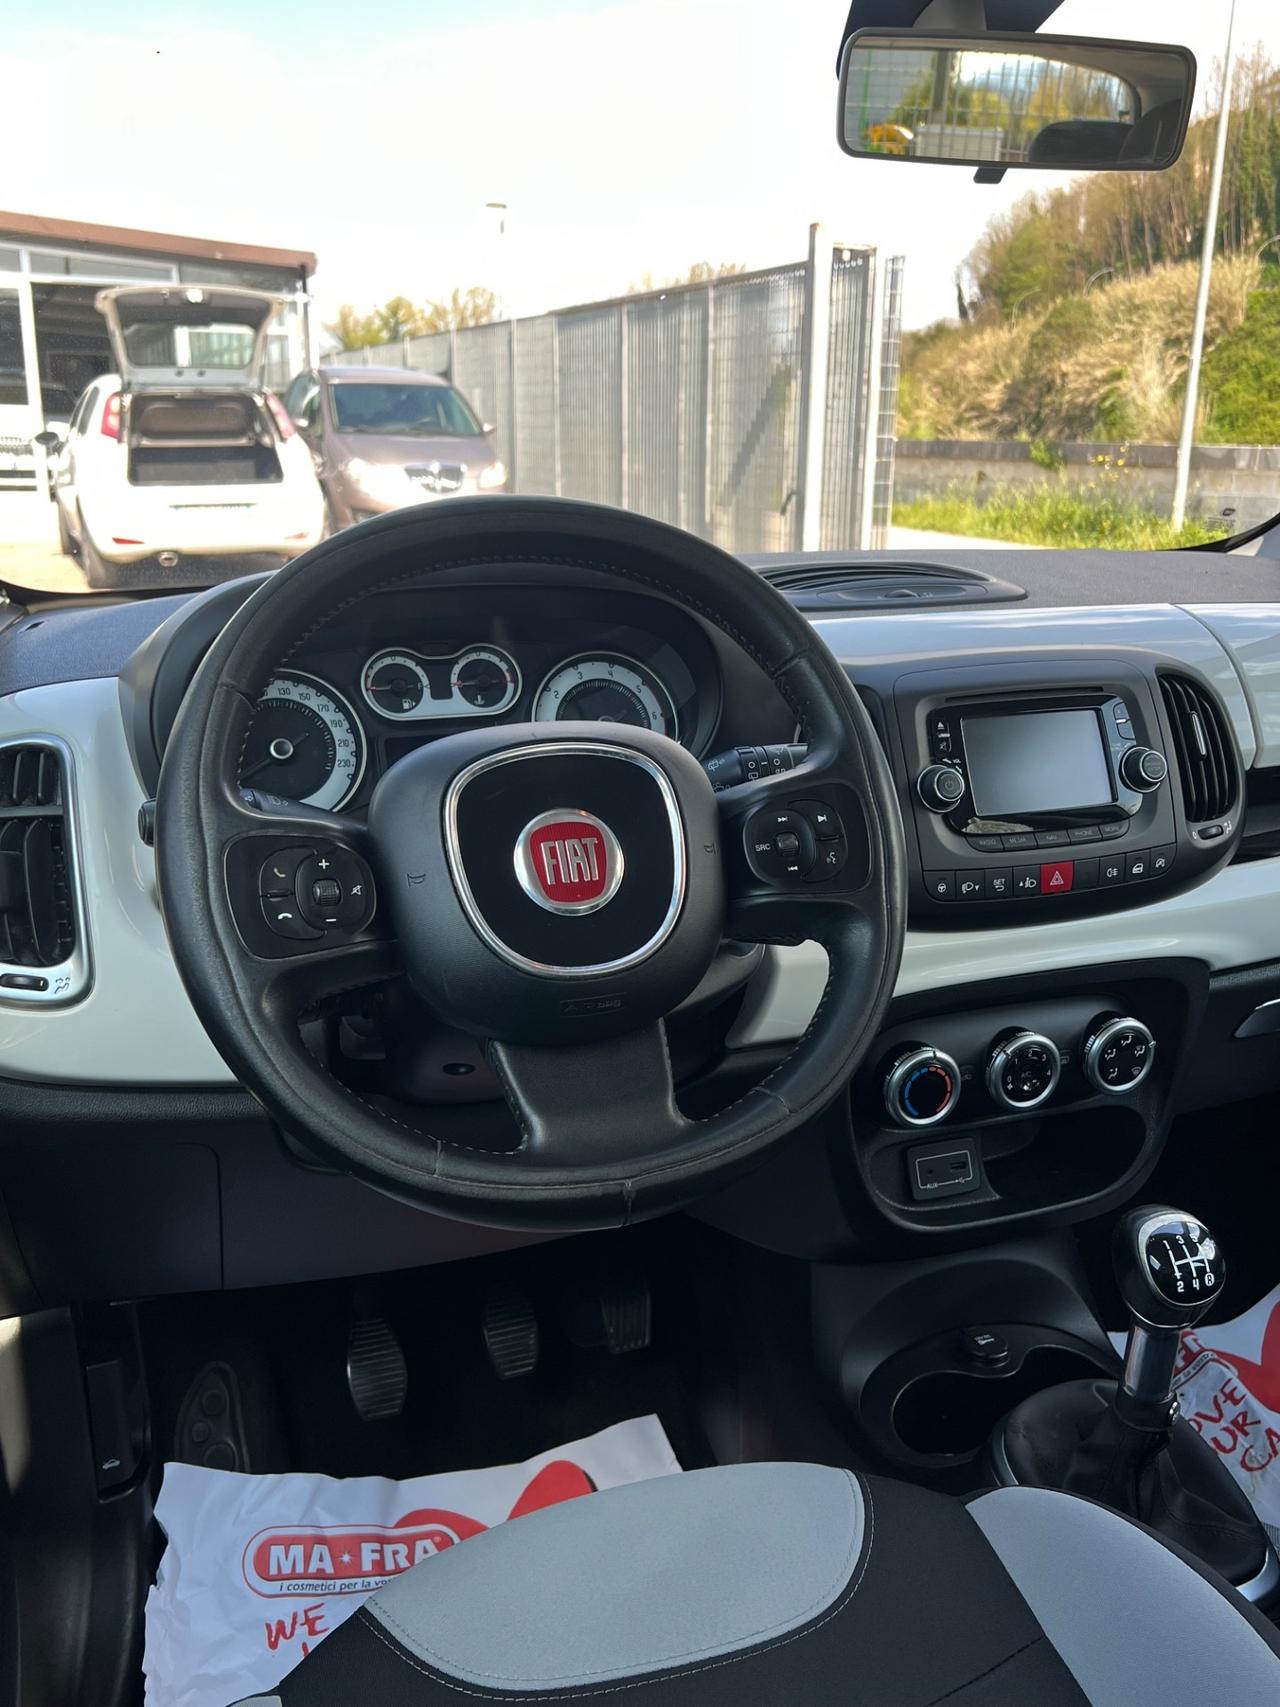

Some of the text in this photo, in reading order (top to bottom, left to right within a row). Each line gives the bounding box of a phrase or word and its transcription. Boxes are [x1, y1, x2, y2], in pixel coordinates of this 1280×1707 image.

[577, 671, 583, 680] 3
[607, 669, 614, 678] 4
[277, 687, 291, 696] 130
[636, 685, 642, 694] 5
[298, 692, 311, 701] 150
[553, 690, 560, 699] 2
[316, 703, 330, 713] 170
[651, 711, 658, 720] 6
[330, 719, 343, 728] 190
[337, 738, 350, 747] 210
[337, 759, 350, 768] 230
[755, 842, 771, 852] SRC
[540, 837, 600, 886] FIAT
[993, 878, 1006, 886] SET
[1028, 1049, 1033, 1057] 2
[1163, 1240, 1170, 1250] 1
[1175, 1234, 1185, 1245] 3
[1176, 1280, 1185, 1293] 2
[1192, 1278, 1200, 1291] 4
[1240, 1426, 1280, 1472] CA
[268, 1538, 440, 1576] MA FRA
[279, 1582, 284, 1592] i
[286, 1581, 337, 1592] cosmetici
[339, 1581, 358, 1592] per
[361, 1579, 371, 1589] la
[265, 1602, 330, 1651] WE
